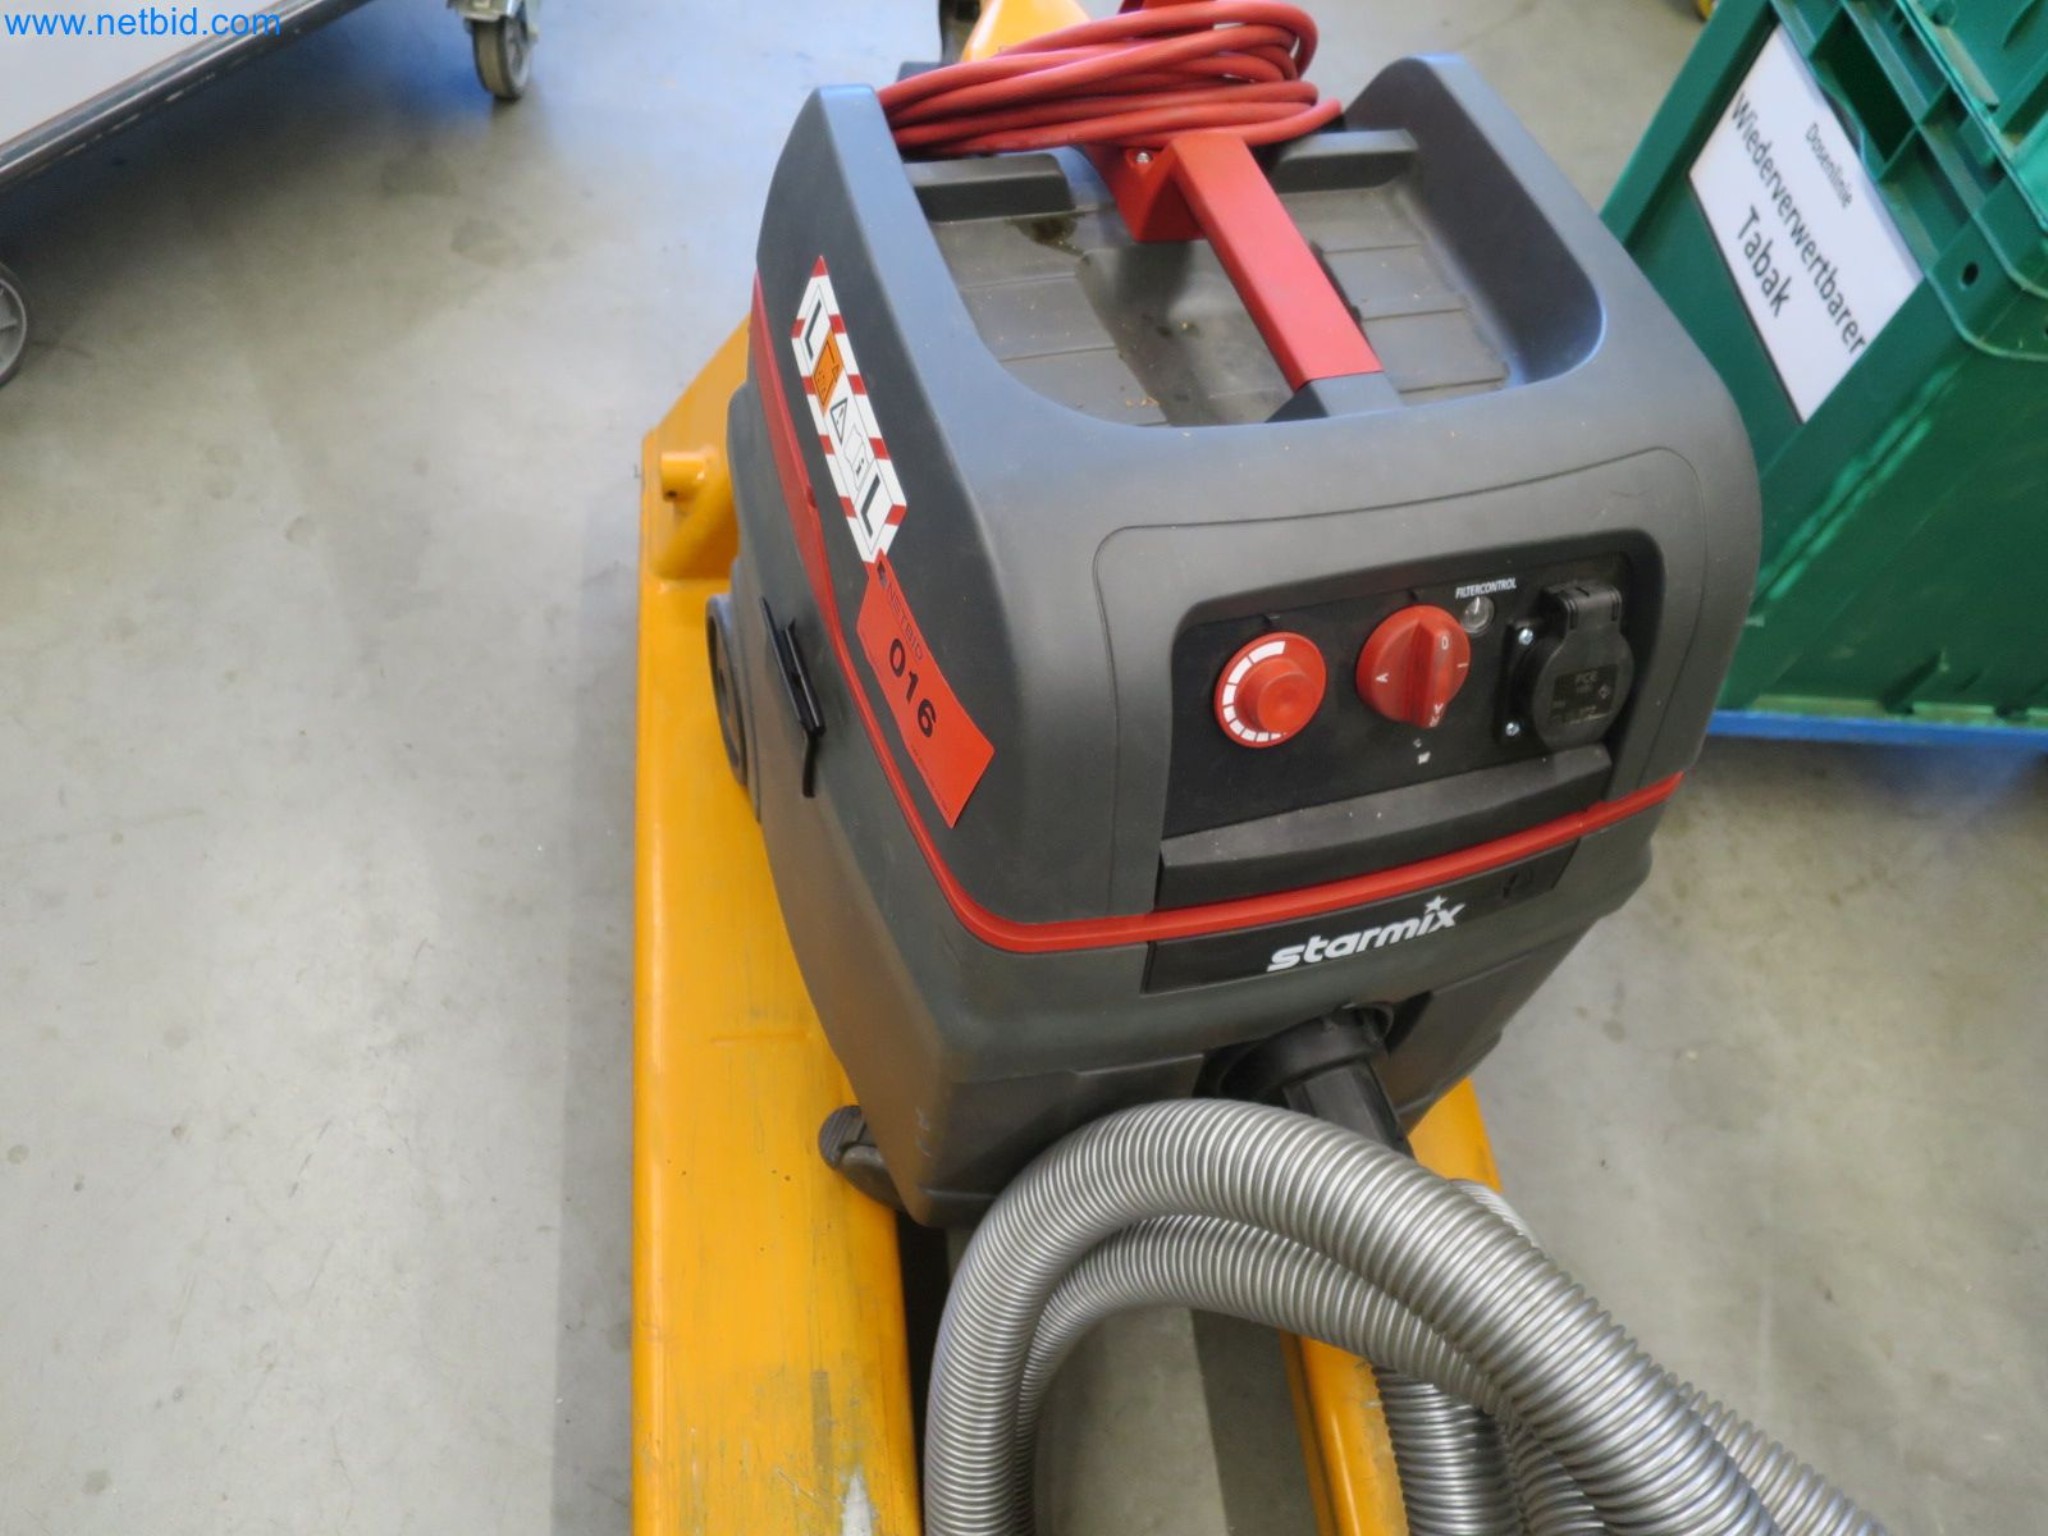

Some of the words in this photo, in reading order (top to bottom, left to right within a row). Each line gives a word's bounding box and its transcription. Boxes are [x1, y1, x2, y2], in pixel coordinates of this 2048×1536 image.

[1731, 93, 1866, 353] Wiederverwertbarer
[1737, 206, 1792, 318] Tabak
[1455, 577, 1517, 599] FILTERCONTROL
[888, 637, 937, 738] 016
[1266, 895, 1466, 972] starmix
